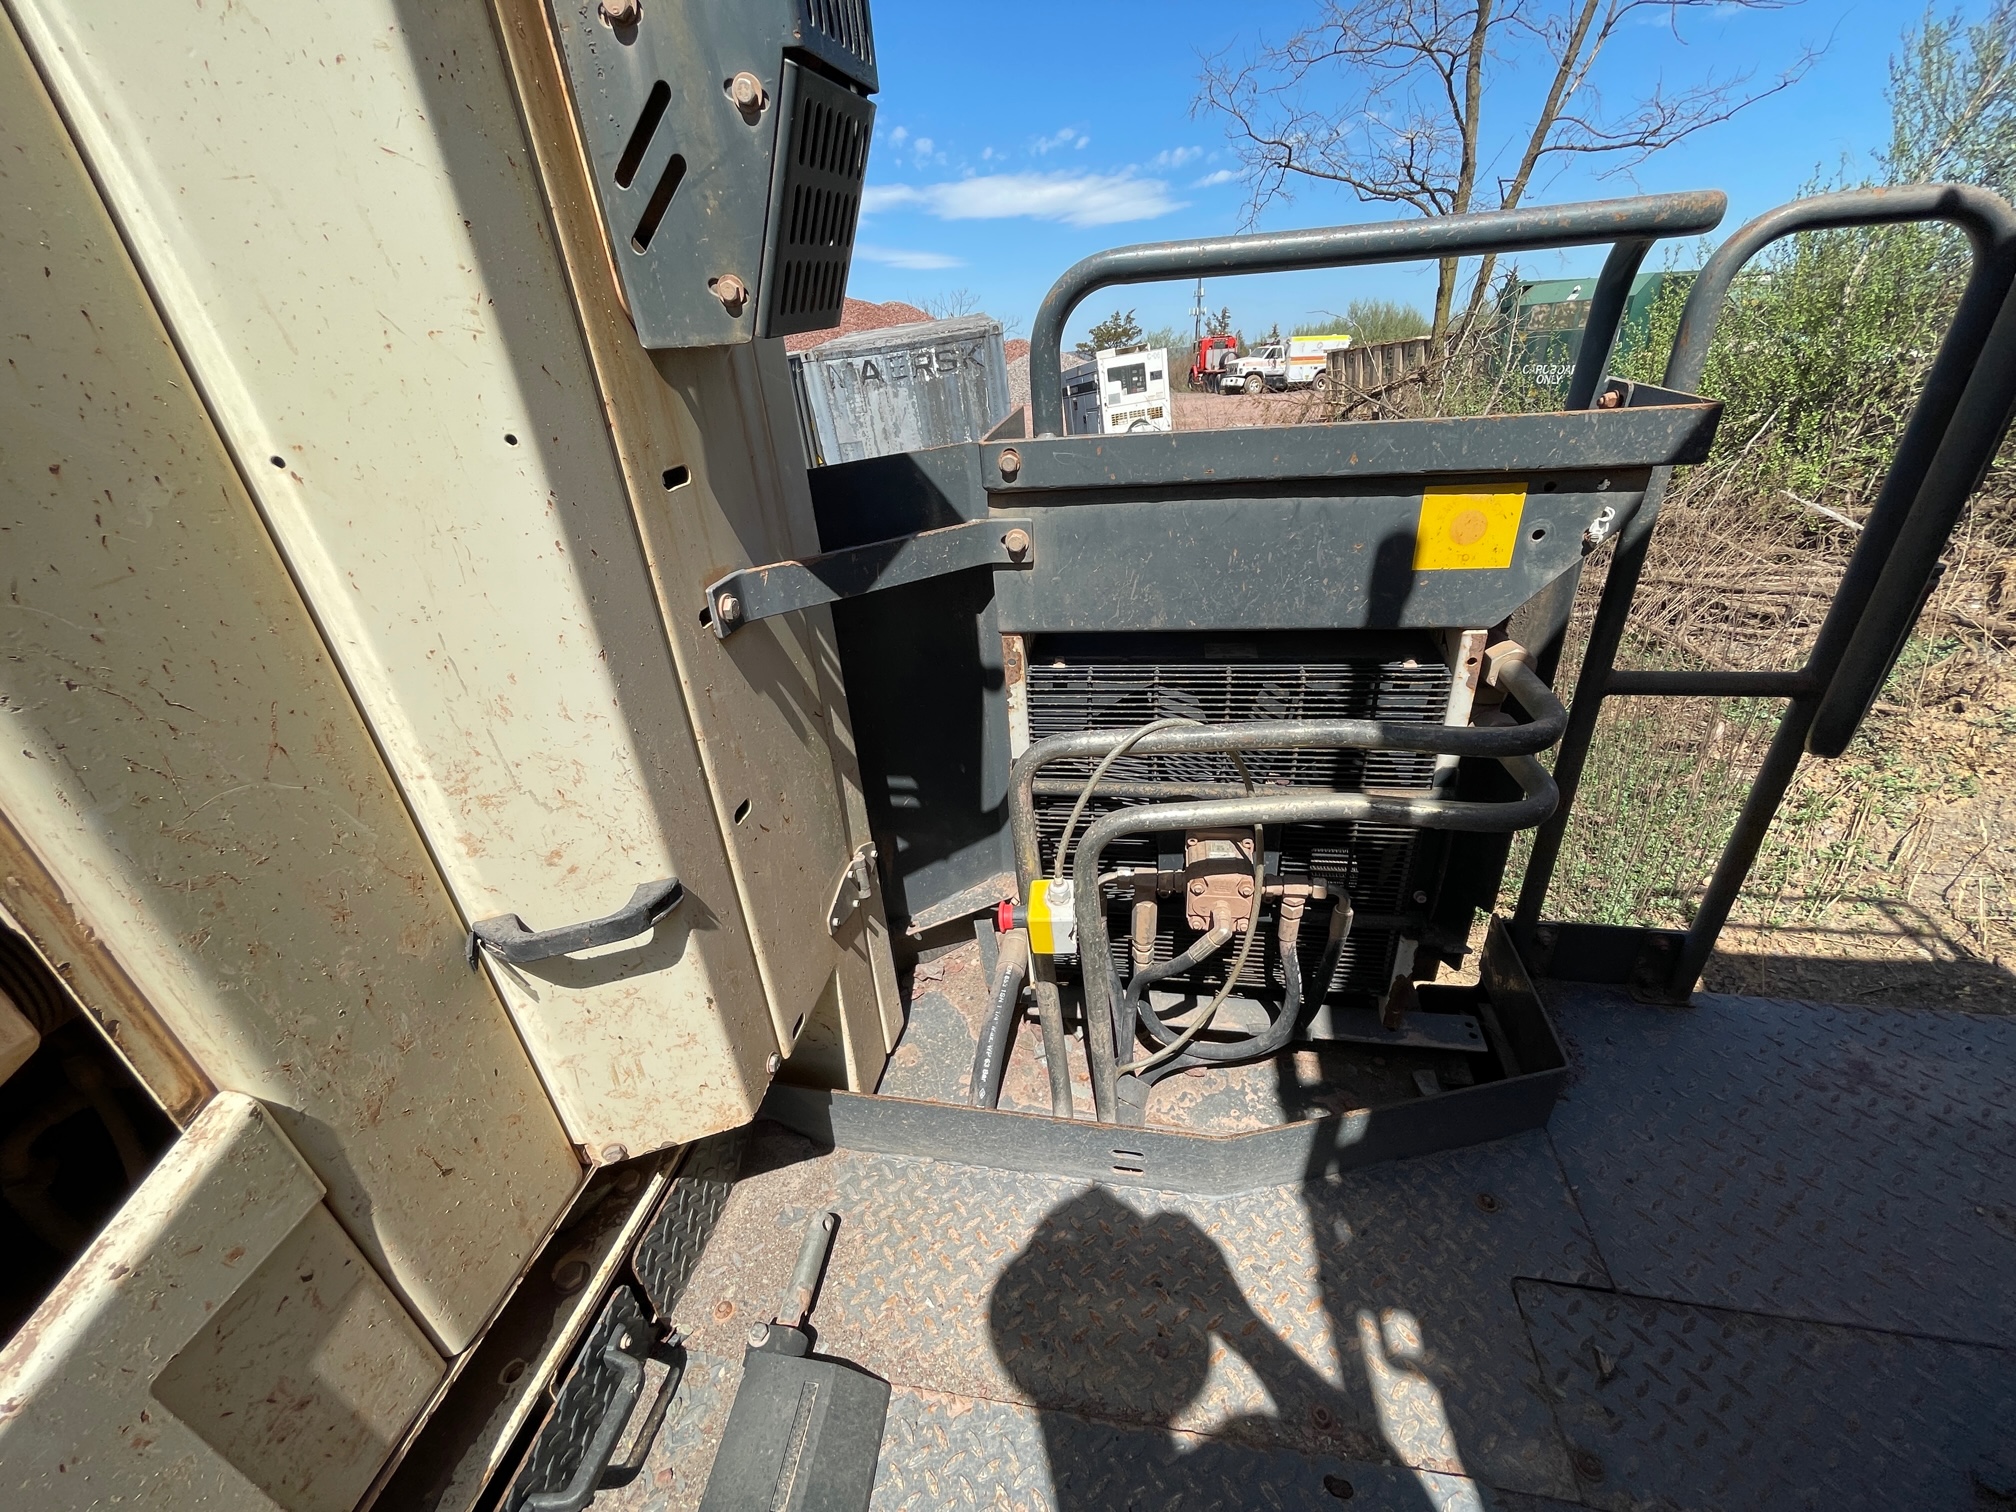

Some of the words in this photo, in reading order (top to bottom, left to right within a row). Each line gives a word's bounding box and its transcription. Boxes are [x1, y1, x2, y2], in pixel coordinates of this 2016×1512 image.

[828, 343, 986, 389] MAERSK
[1536, 374, 1563, 385] ONLY
[983, 1058, 991, 1068] 63
[981, 1069, 989, 1083] Bar
